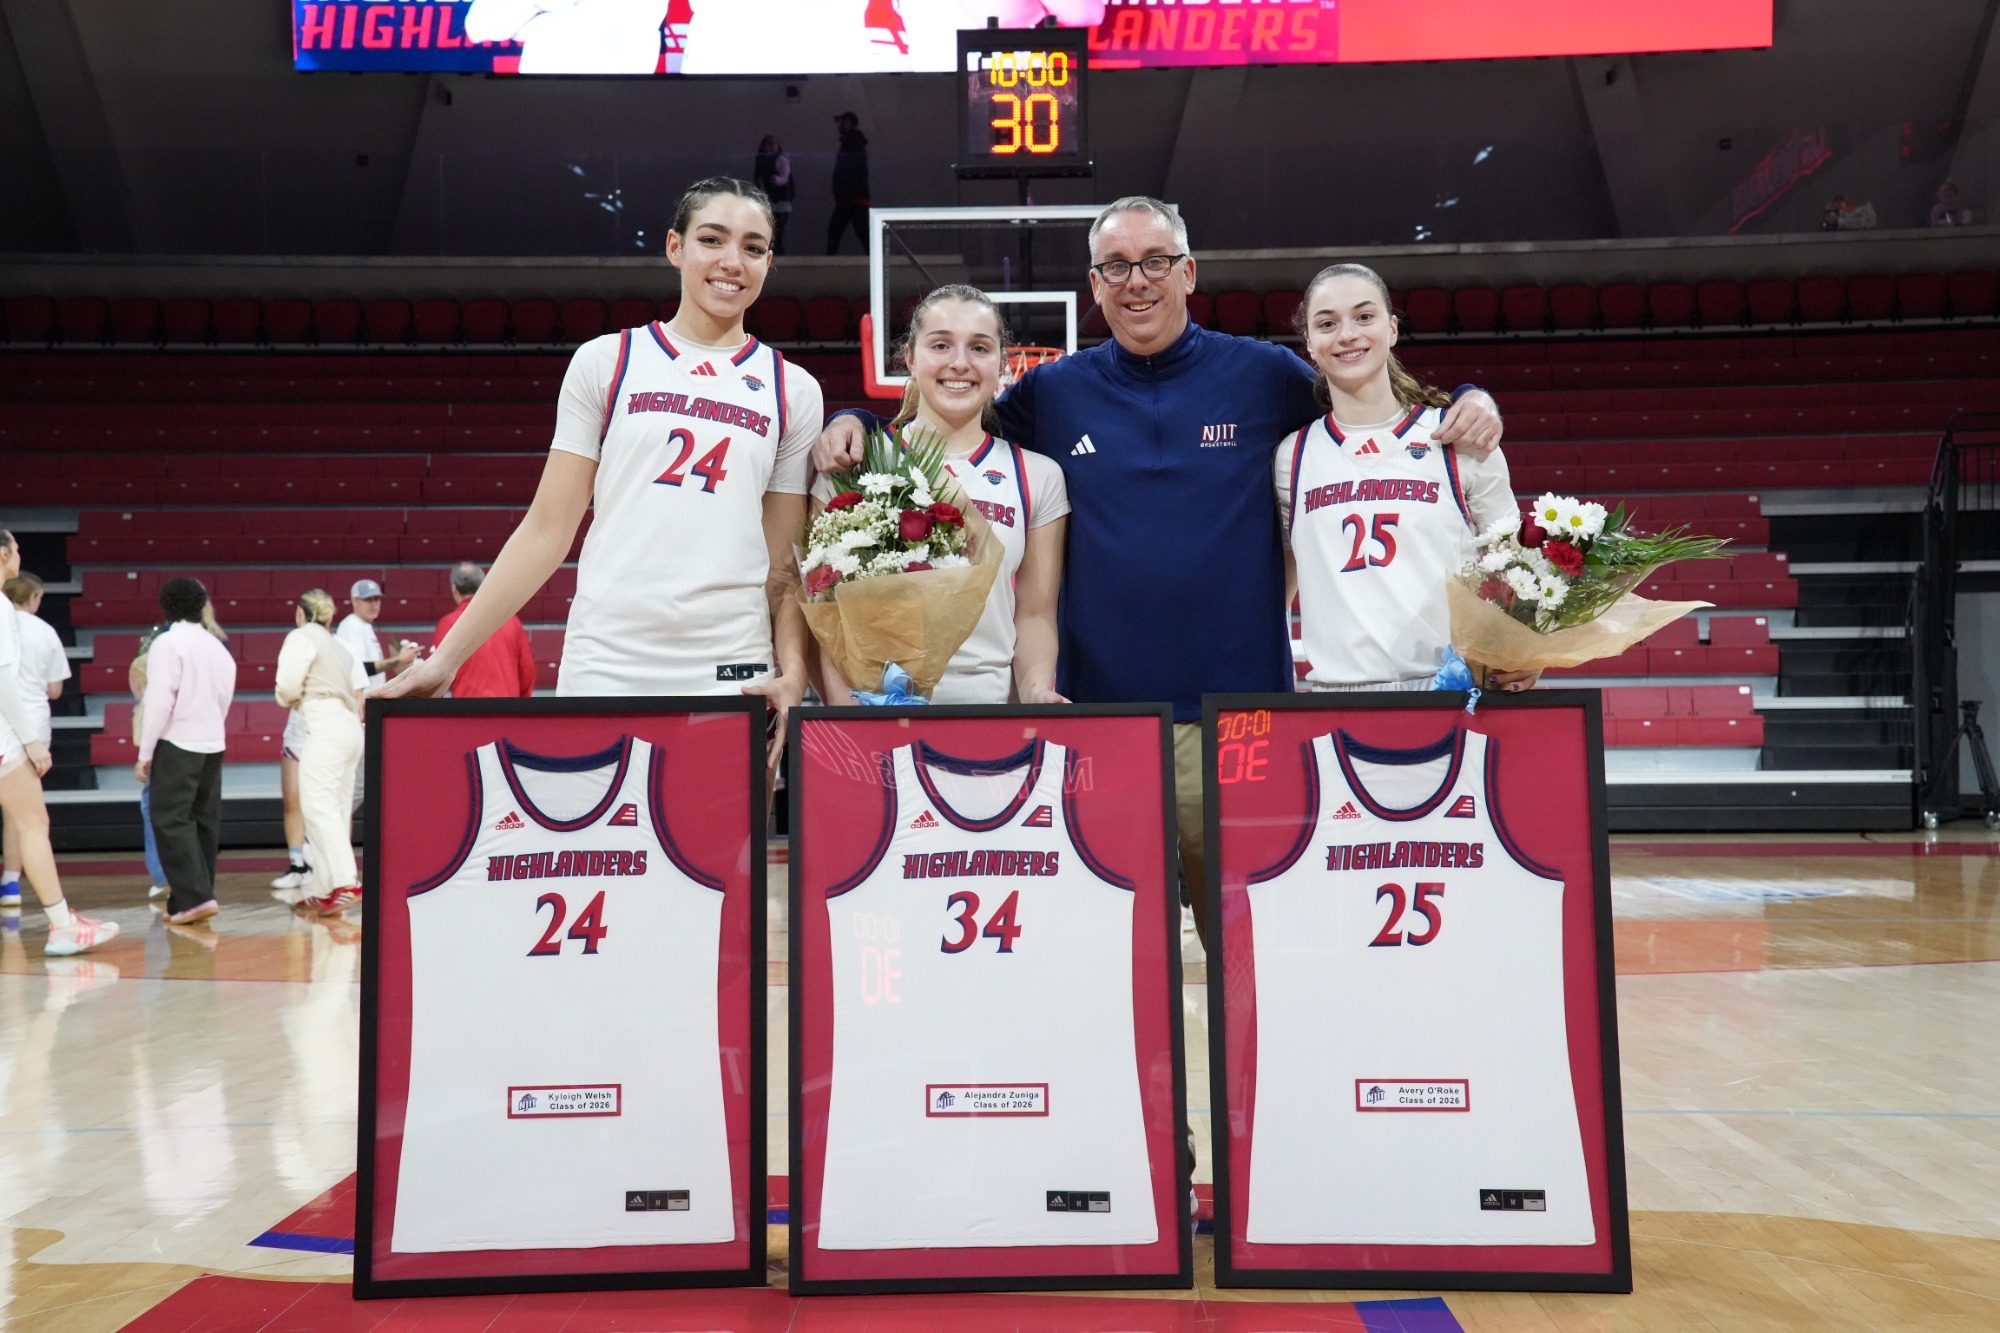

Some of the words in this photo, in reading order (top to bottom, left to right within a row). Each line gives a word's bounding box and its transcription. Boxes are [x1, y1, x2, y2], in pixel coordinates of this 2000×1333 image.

[991, 52, 1068, 87] 10:00
[992, 93, 1058, 153] 30
[628, 392, 771, 437] HIGHLANDERS
[1202, 424, 1237, 443] NJIT
[652, 428, 731, 494] 24
[1305, 479, 1439, 514] HIGHLANDERS
[1340, 513, 1400, 572] 25
[495, 820, 525, 830] adidas
[910, 821, 939, 830] adidas
[1333, 811, 1361, 820] adidas
[487, 850, 647, 881] HIGHLANDERS
[902, 850, 1059, 879] HIGHLANDERS
[1326, 841, 1483, 871] HIGHLANDERS
[526, 891, 608, 956] 24
[941, 890, 1022, 954] 34
[1368, 882, 1445, 947] 25
[548, 1092, 582, 1102] Kyleigh
[584, 1092, 612, 1100] Welsh
[589, 1101, 610, 1109] 2026
[964, 1091, 1006, 1100] Alejandra
[1009, 1091, 1039, 1100] Zuniga
[973, 1101, 998, 1109] Class
[1012, 1101, 1033, 1109] 2026
[1398, 1087, 1424, 1096] Avery
[1427, 1087, 1459, 1095] O'Roke
[1399, 1096, 1424, 1104] Class
[1427, 1096, 1436, 1104] of
[1439, 1096, 1460, 1104] 2026
